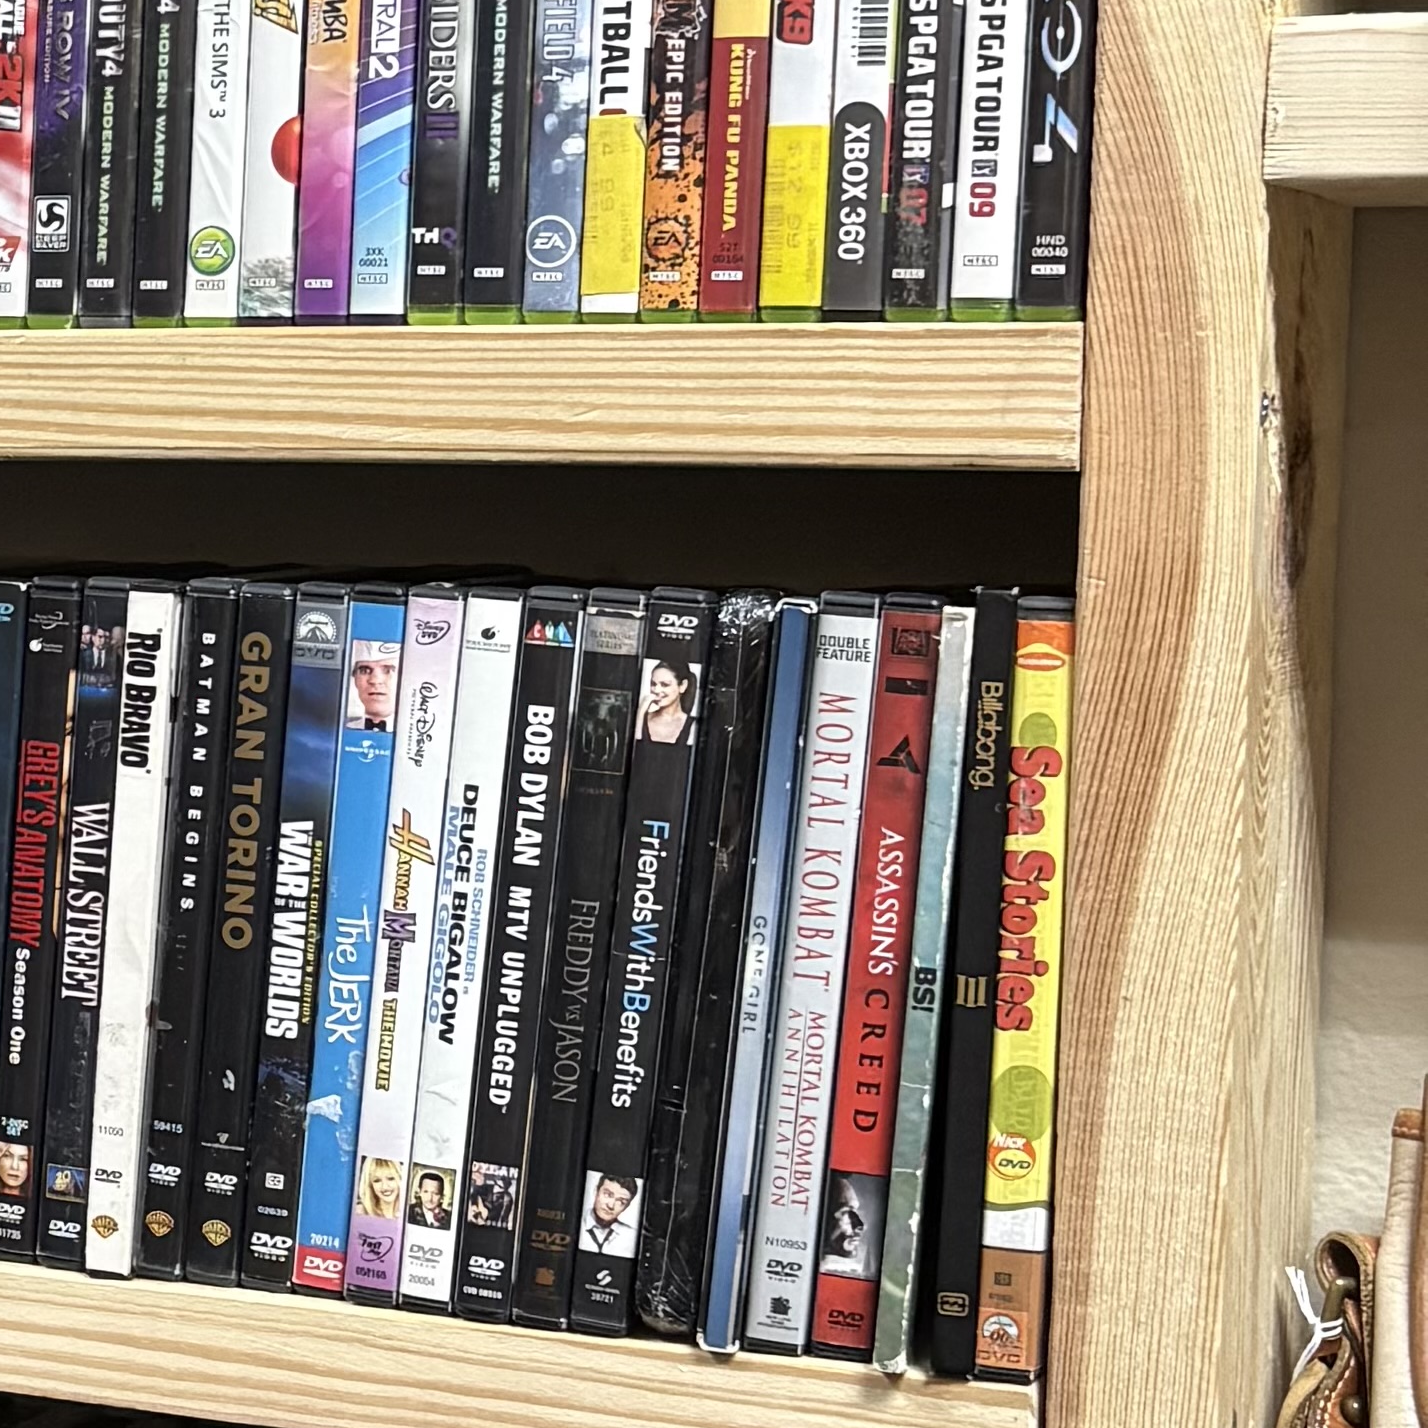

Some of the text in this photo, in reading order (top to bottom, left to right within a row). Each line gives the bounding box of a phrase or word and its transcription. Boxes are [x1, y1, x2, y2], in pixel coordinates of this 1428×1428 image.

[369, 54, 400, 80] 2
[839, 122, 871, 263] XBOX 360
[222, 631, 272, 949] GRAN TORINO
[488, 704, 555, 1106] BOB DYLAN MTV UNPLUGGED
[993, 746, 1063, 1034] Sea Stories
[853, 828, 906, 1135] ASSASSIN'S CREED
